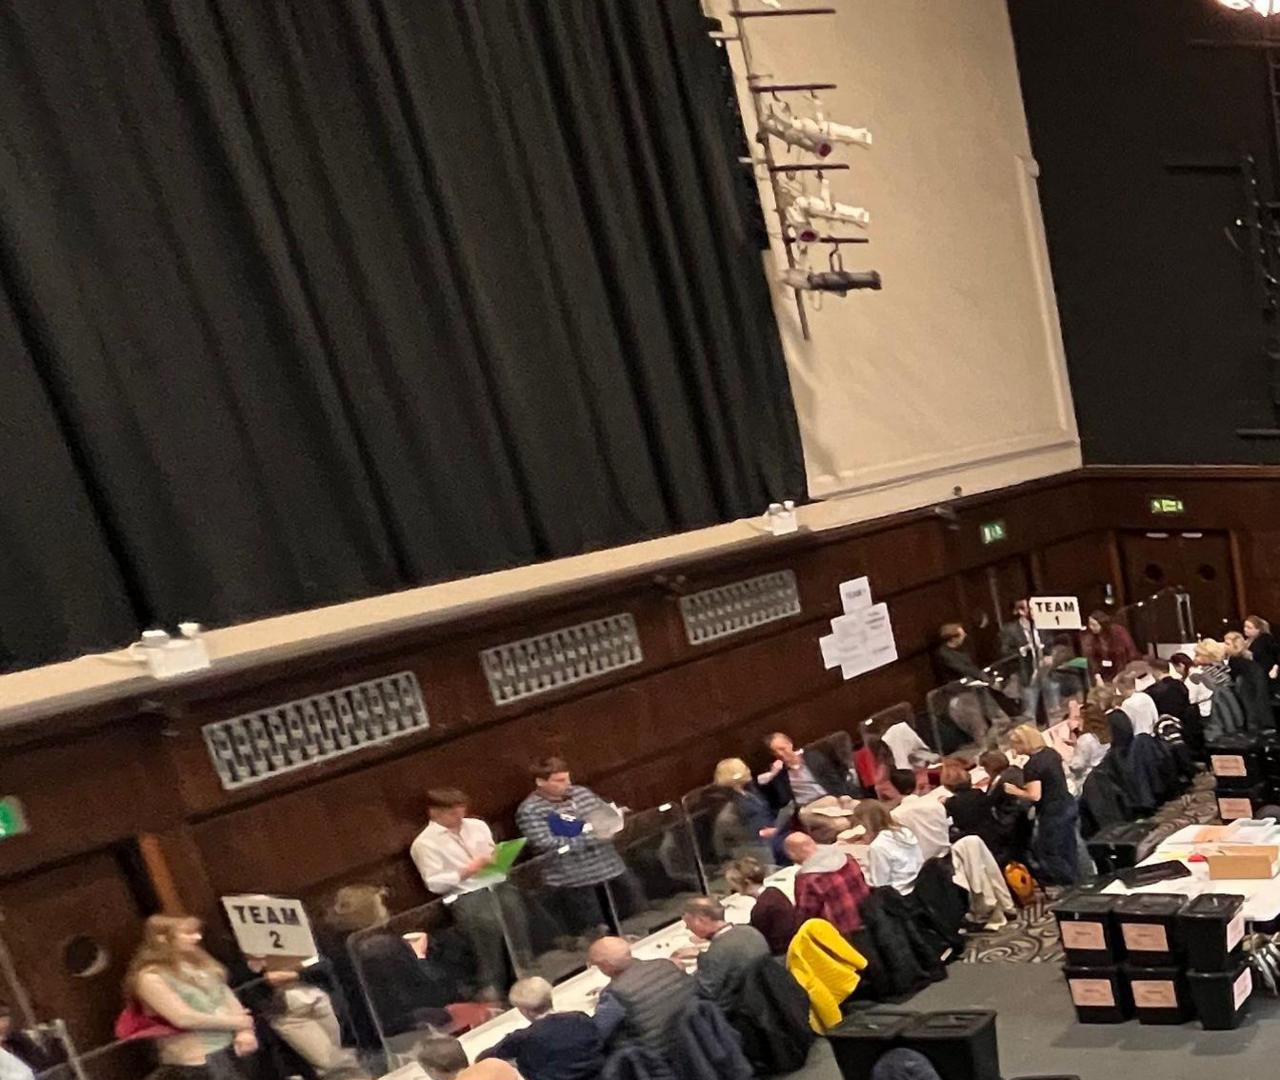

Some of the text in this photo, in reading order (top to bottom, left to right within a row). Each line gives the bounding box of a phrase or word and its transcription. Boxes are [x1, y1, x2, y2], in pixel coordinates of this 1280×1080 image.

[1035, 601, 1075, 612] TEAM
[1055, 615, 1060, 626] 1
[232, 904, 301, 926] TEAM
[269, 930, 284, 948] 2
